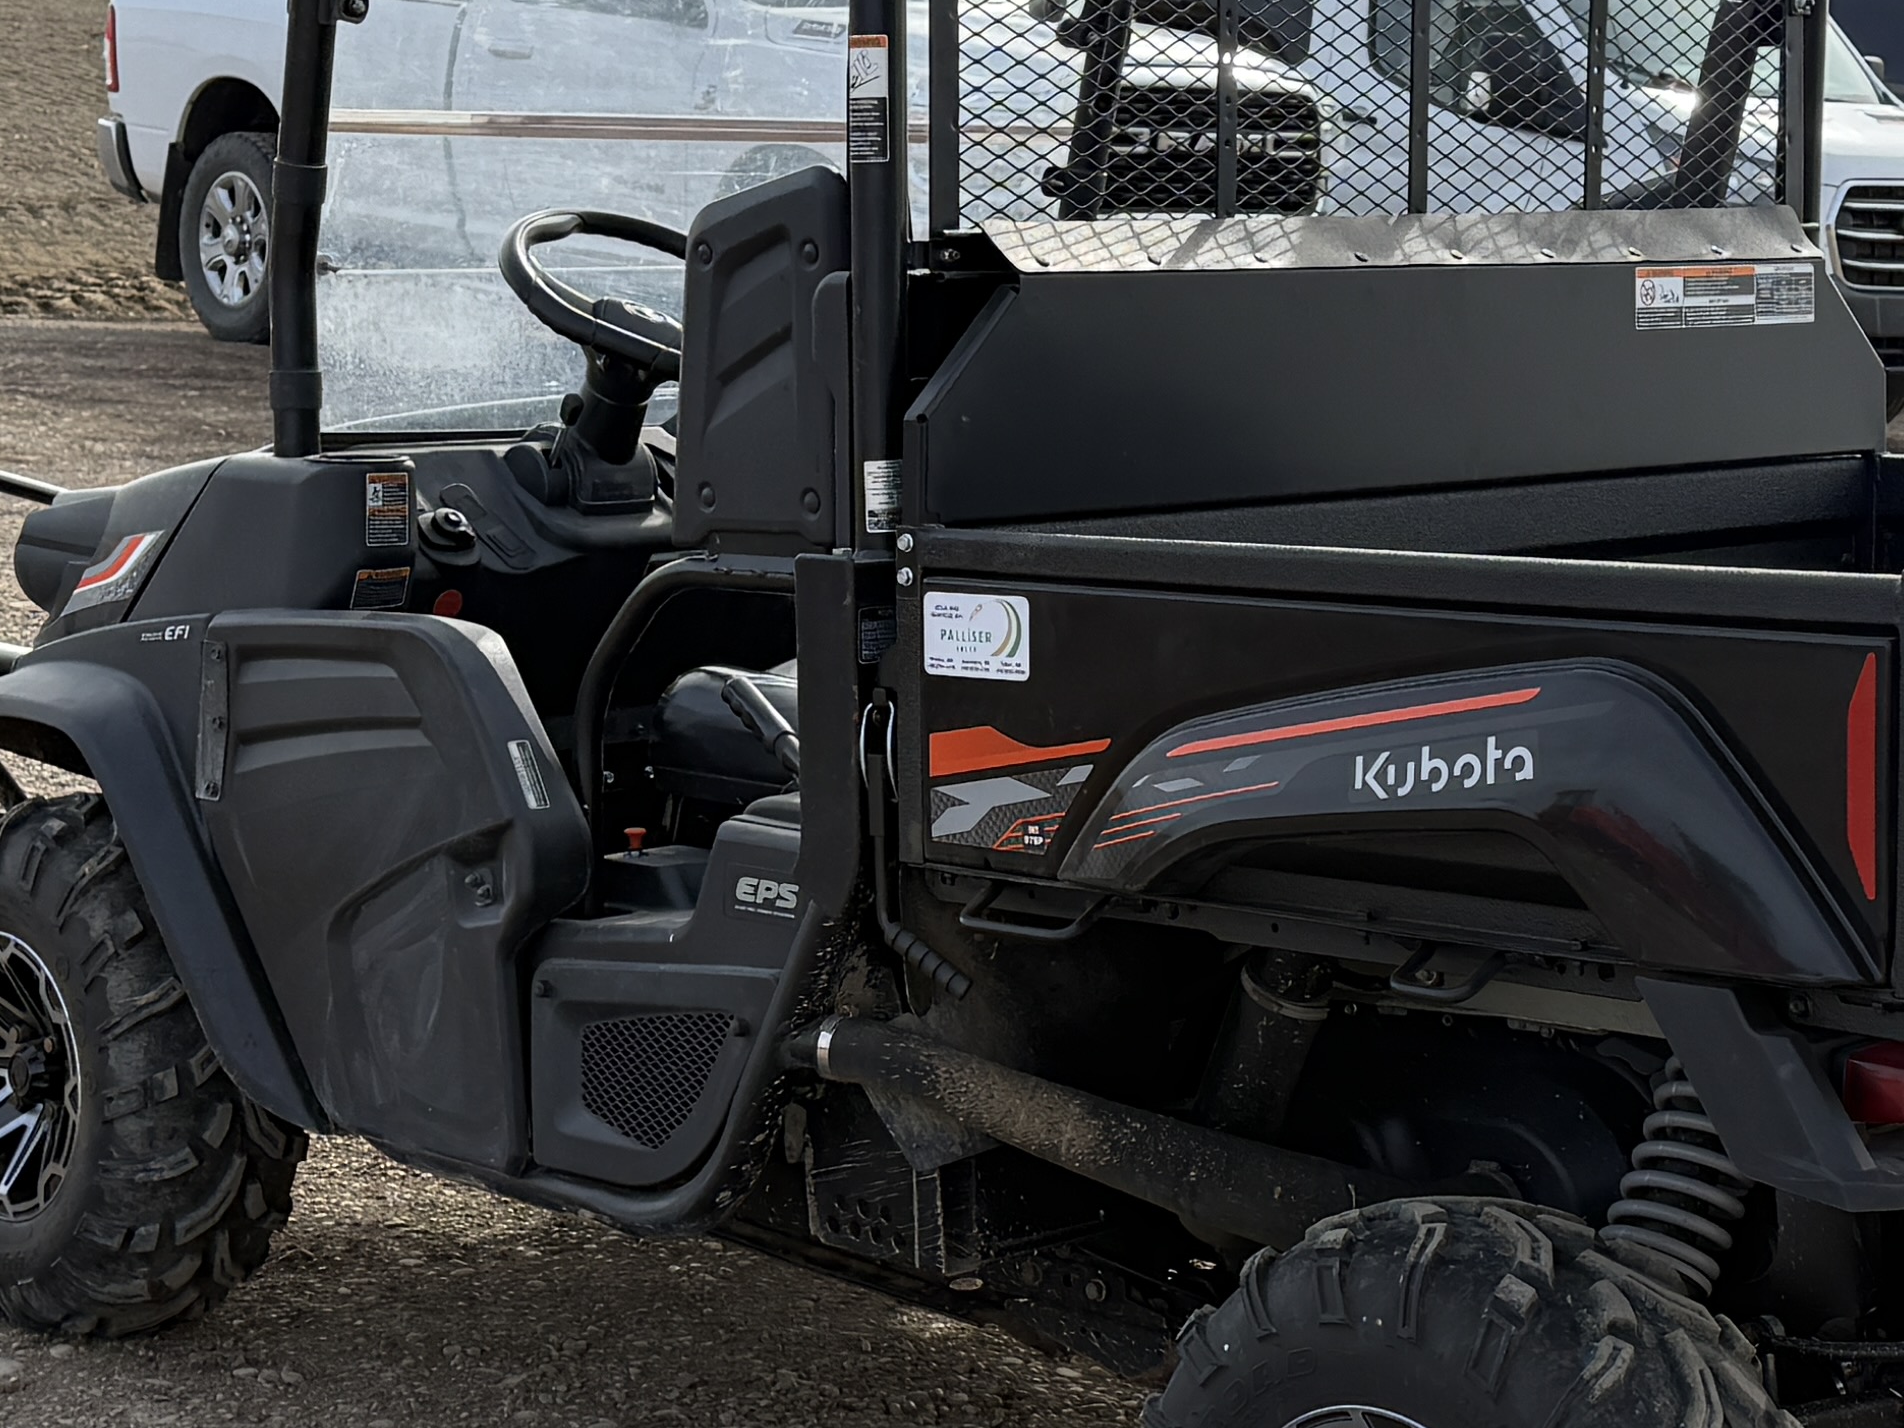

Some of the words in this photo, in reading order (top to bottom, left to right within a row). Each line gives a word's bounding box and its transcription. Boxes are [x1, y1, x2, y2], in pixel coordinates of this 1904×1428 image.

[164, 625, 190, 641] EFI
[1354, 735, 1534, 800] Kubota
[735, 876, 800, 909] EPS
